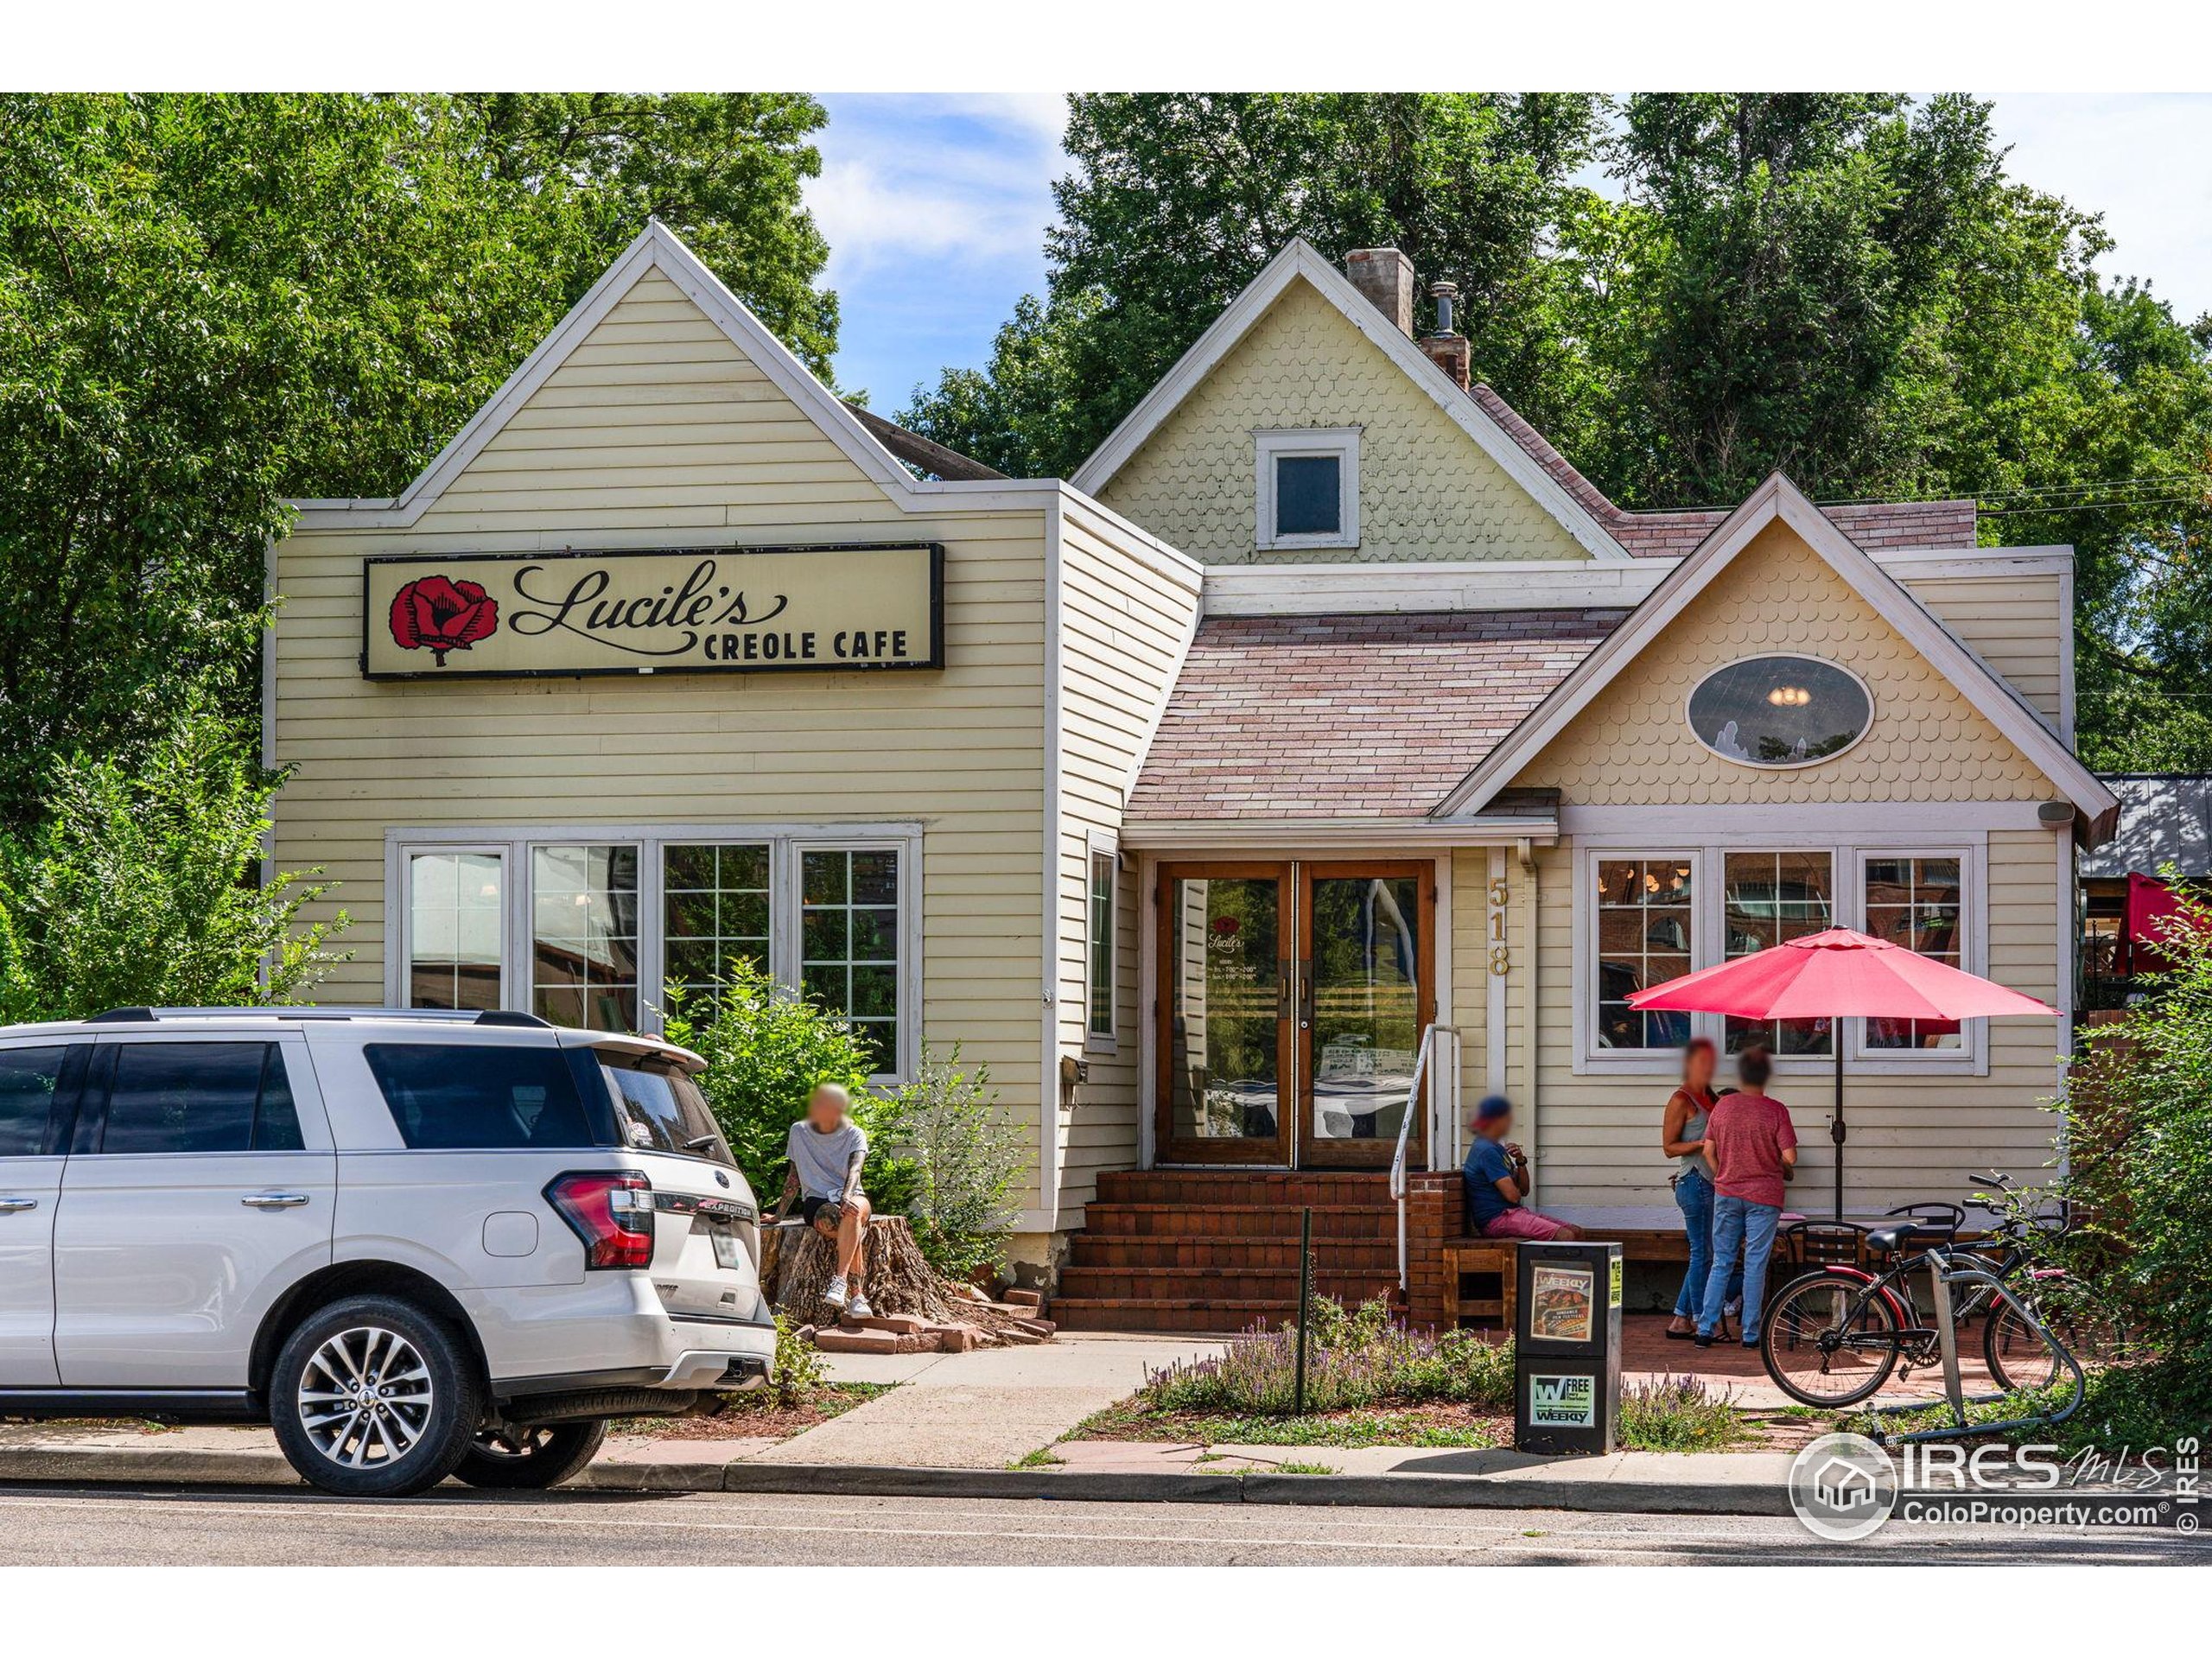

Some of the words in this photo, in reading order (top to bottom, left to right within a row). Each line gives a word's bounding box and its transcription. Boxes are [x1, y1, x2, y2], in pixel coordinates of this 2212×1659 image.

[508, 560, 788, 656] Lucile's
[704, 632, 816, 660] CREOLE
[833, 631, 907, 658] CAFE
[1490, 878, 1509, 976] 518
[1539, 1274, 1589, 1290] WEEKLY
[1567, 1379, 1589, 1392] FREE
[1536, 1408, 1588, 1424] WEEKLY
